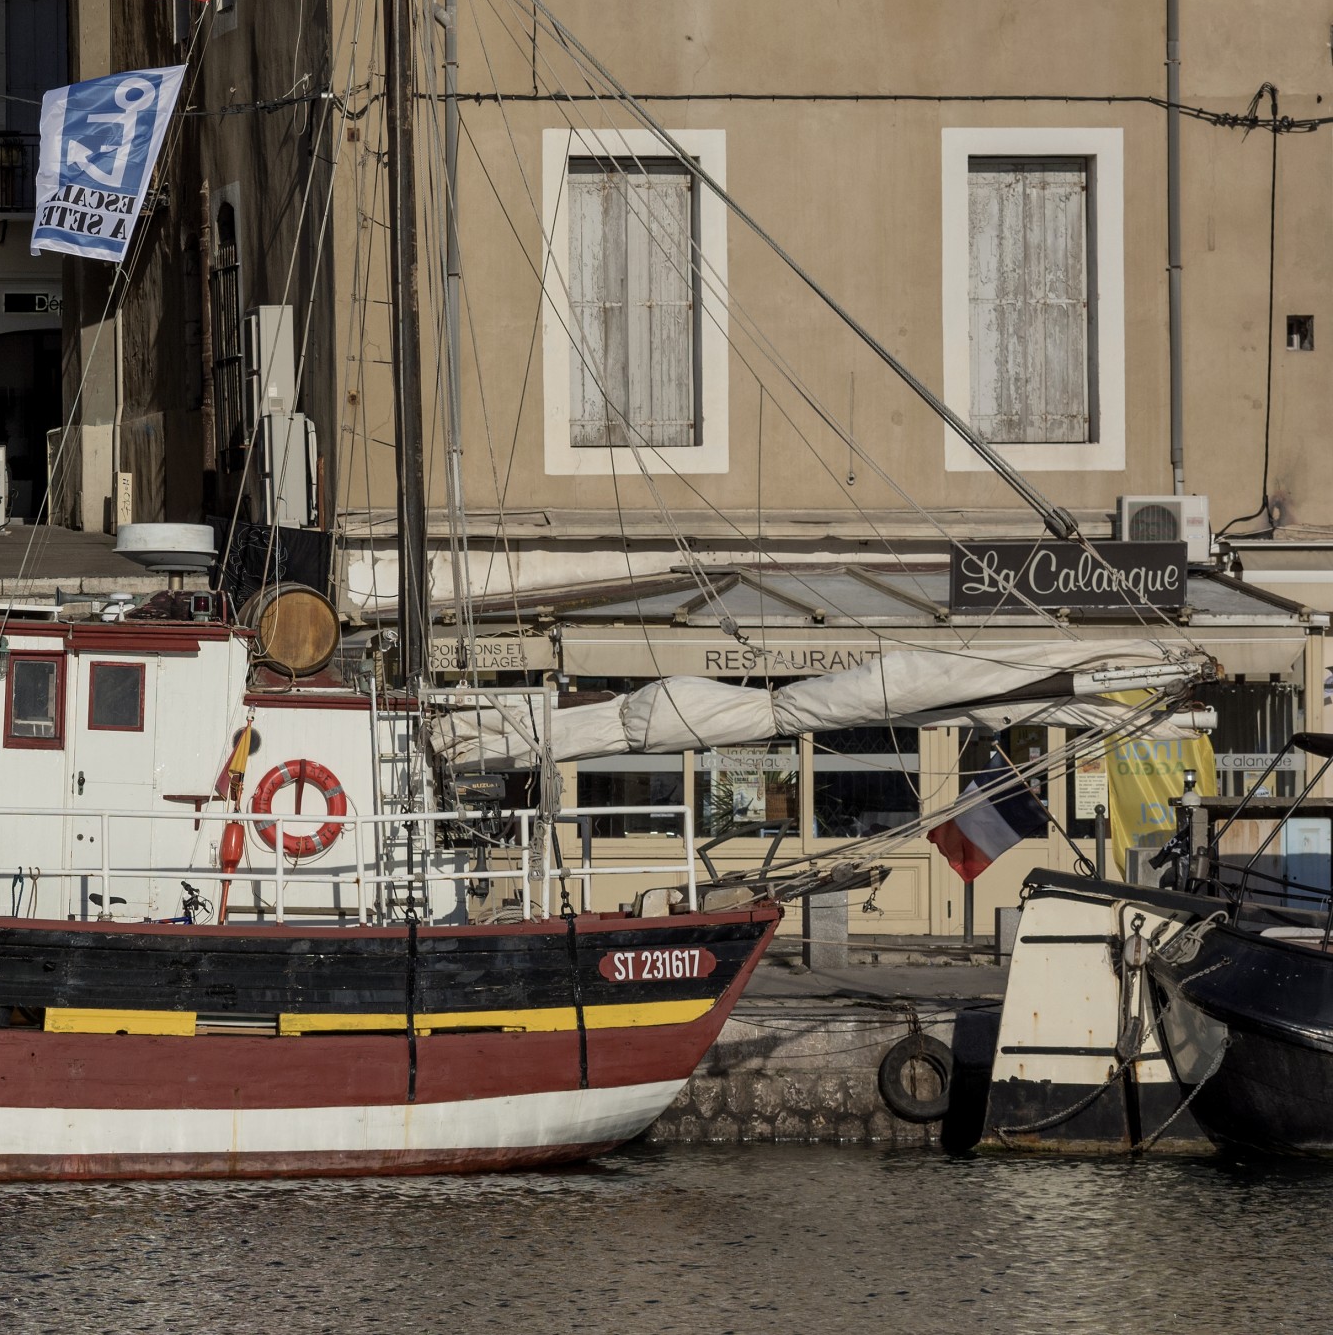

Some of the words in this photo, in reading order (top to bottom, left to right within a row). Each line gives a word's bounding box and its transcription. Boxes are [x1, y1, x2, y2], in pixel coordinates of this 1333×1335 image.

[961, 550, 1017, 595] La
[1029, 549, 1179, 604] Calanque
[506, 644, 522, 655] ET
[705, 650, 881, 670] RESTAURANT
[613, 952, 636, 980] ST
[641, 950, 700, 979] 231617
